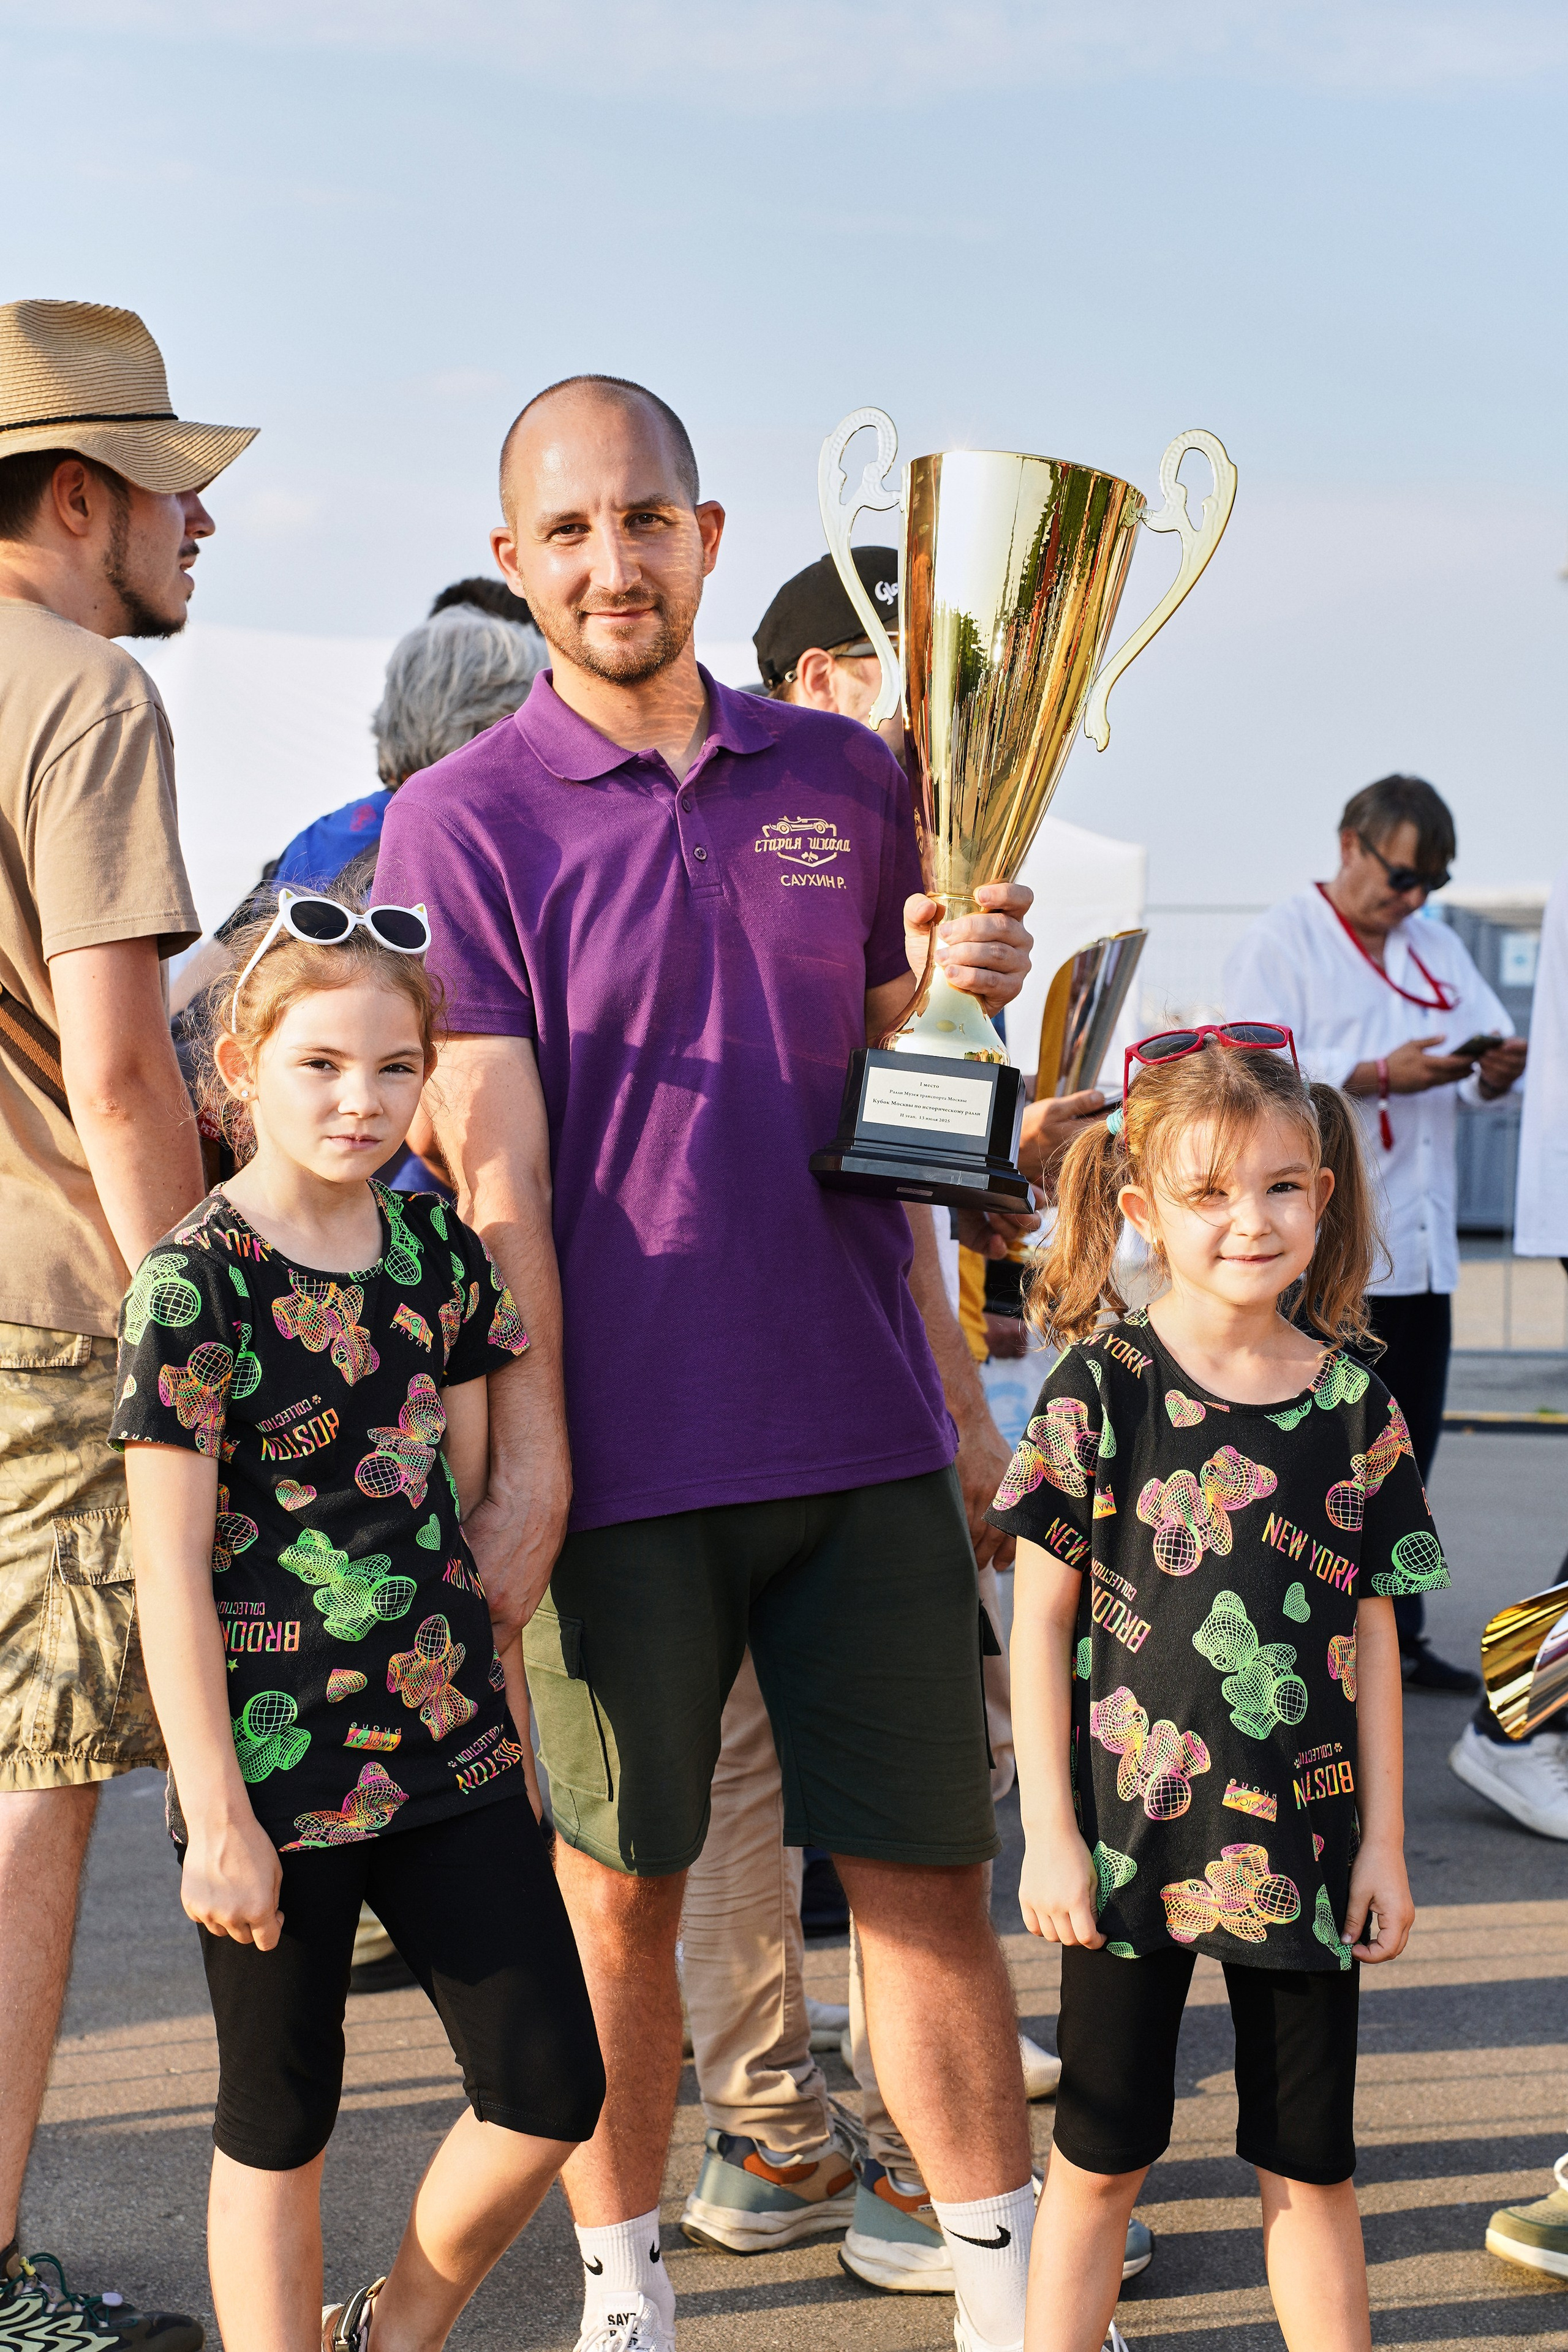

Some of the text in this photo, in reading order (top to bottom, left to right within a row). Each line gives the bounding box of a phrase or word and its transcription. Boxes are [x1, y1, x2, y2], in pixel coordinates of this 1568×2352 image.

[780, 874, 847, 889] САУХИН Р.
[922, 1106, 964, 1115] историческому
[1104, 1333, 1153, 1379] YORK
[255, 1399, 313, 1433] COLLECTION
[1262, 1512, 1359, 1596] NEW YORK
[351, 1735, 398, 1749] MAGICAL
[456, 1737, 523, 1795] BOSTON
[1229, 1793, 1275, 1815] MAGICAL
